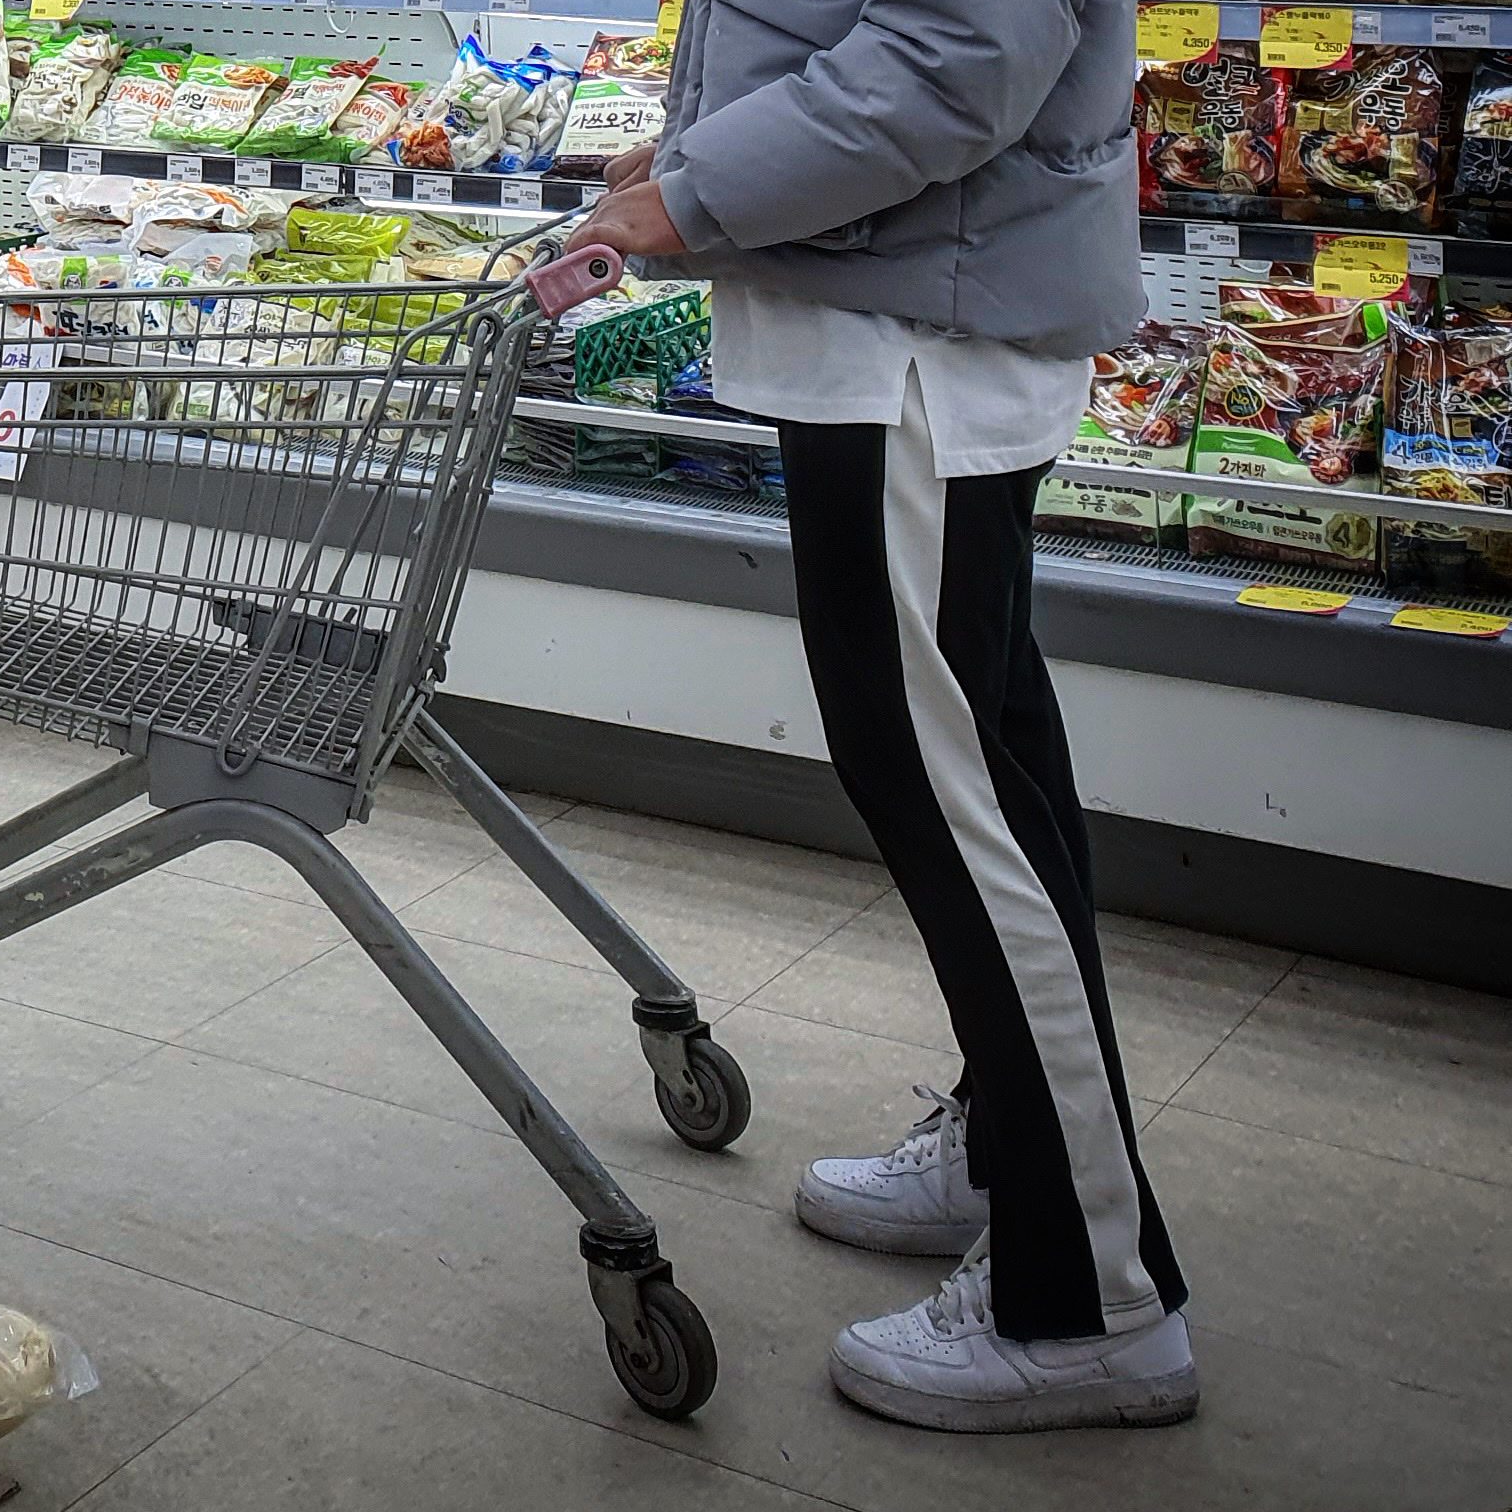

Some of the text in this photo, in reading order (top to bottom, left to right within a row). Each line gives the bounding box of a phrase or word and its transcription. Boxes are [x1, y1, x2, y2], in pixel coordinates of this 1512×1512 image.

[571, 110, 643, 134] 가쓰오진
[1197, 99, 1244, 127] 우동
[1356, 94, 1407, 130] 우동
[1217, 457, 1253, 476] 2가지
[1077, 492, 1107, 514] 우동
